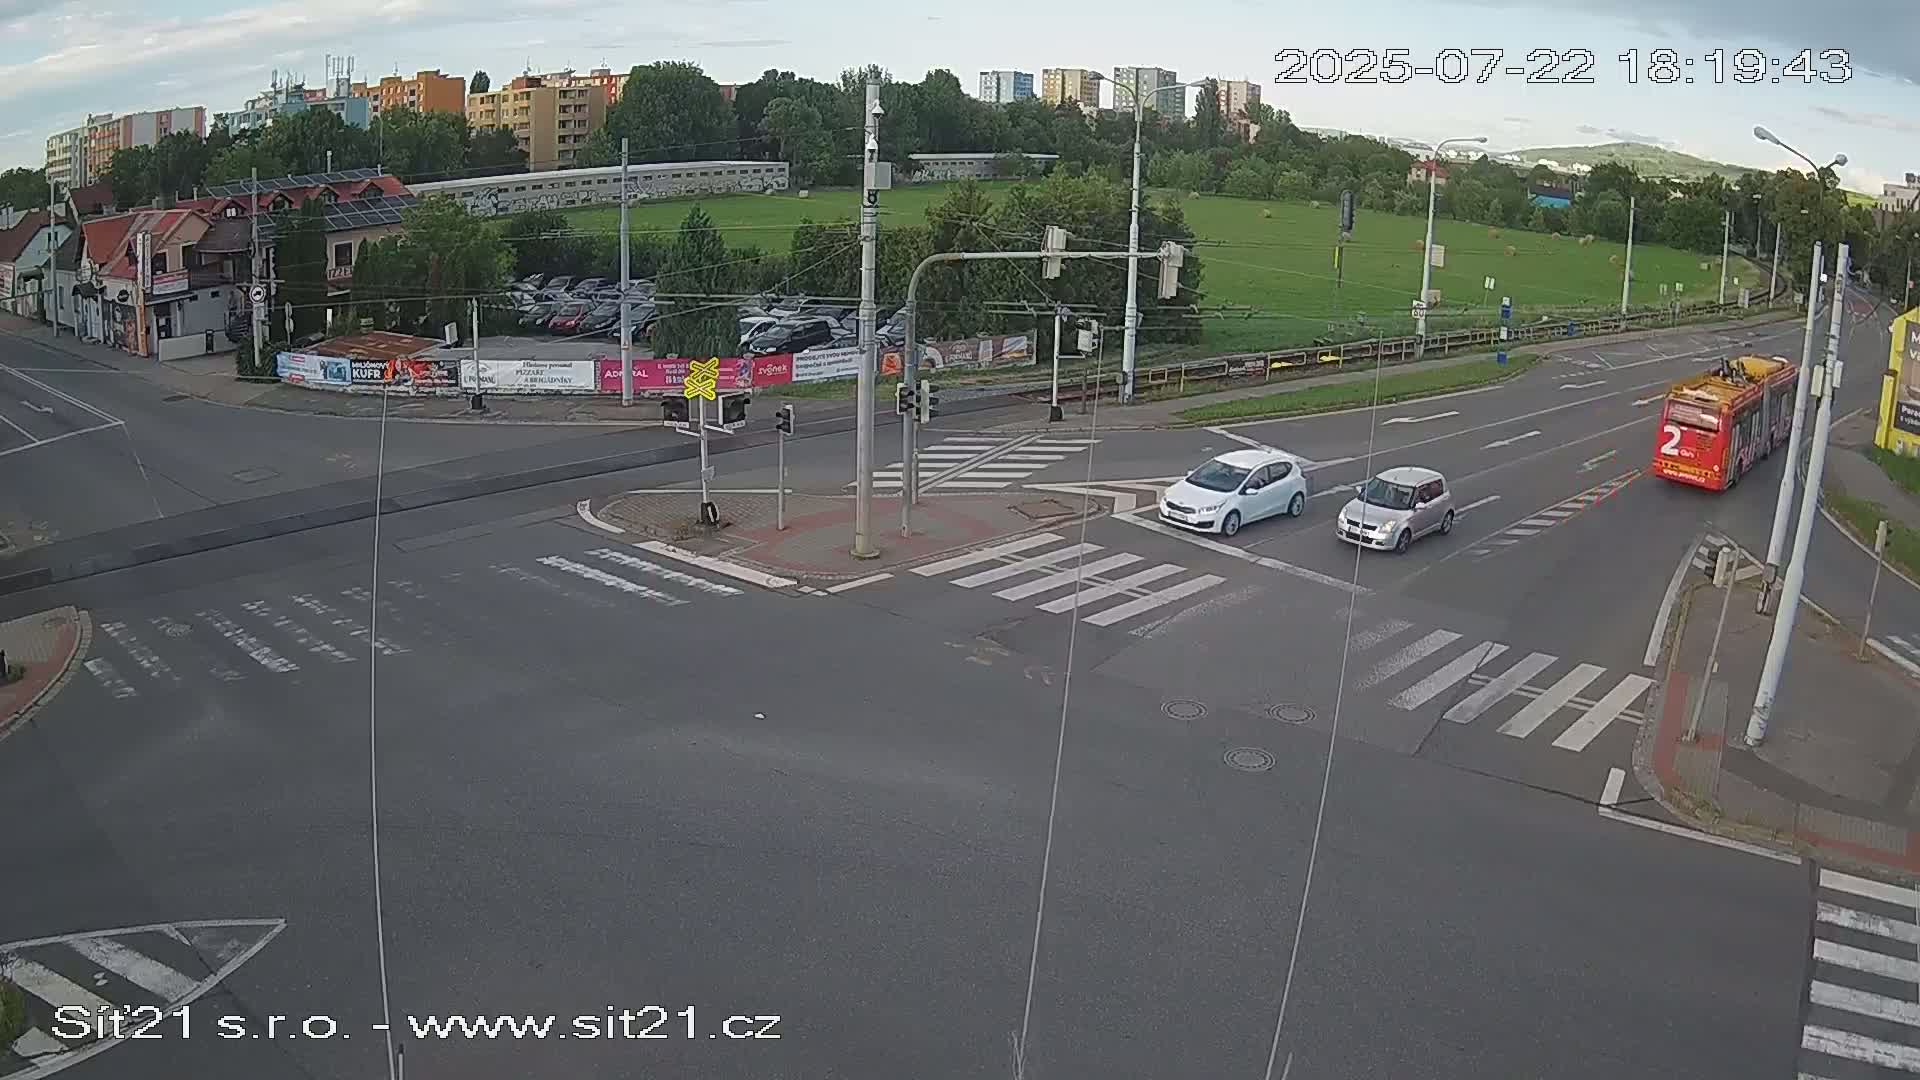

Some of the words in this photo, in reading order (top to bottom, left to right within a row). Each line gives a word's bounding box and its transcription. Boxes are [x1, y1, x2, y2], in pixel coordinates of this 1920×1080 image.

[352, 368, 382, 379] KUFR
[604, 369, 648, 378] ADMRAL
[1660, 424, 1681, 457] 2
